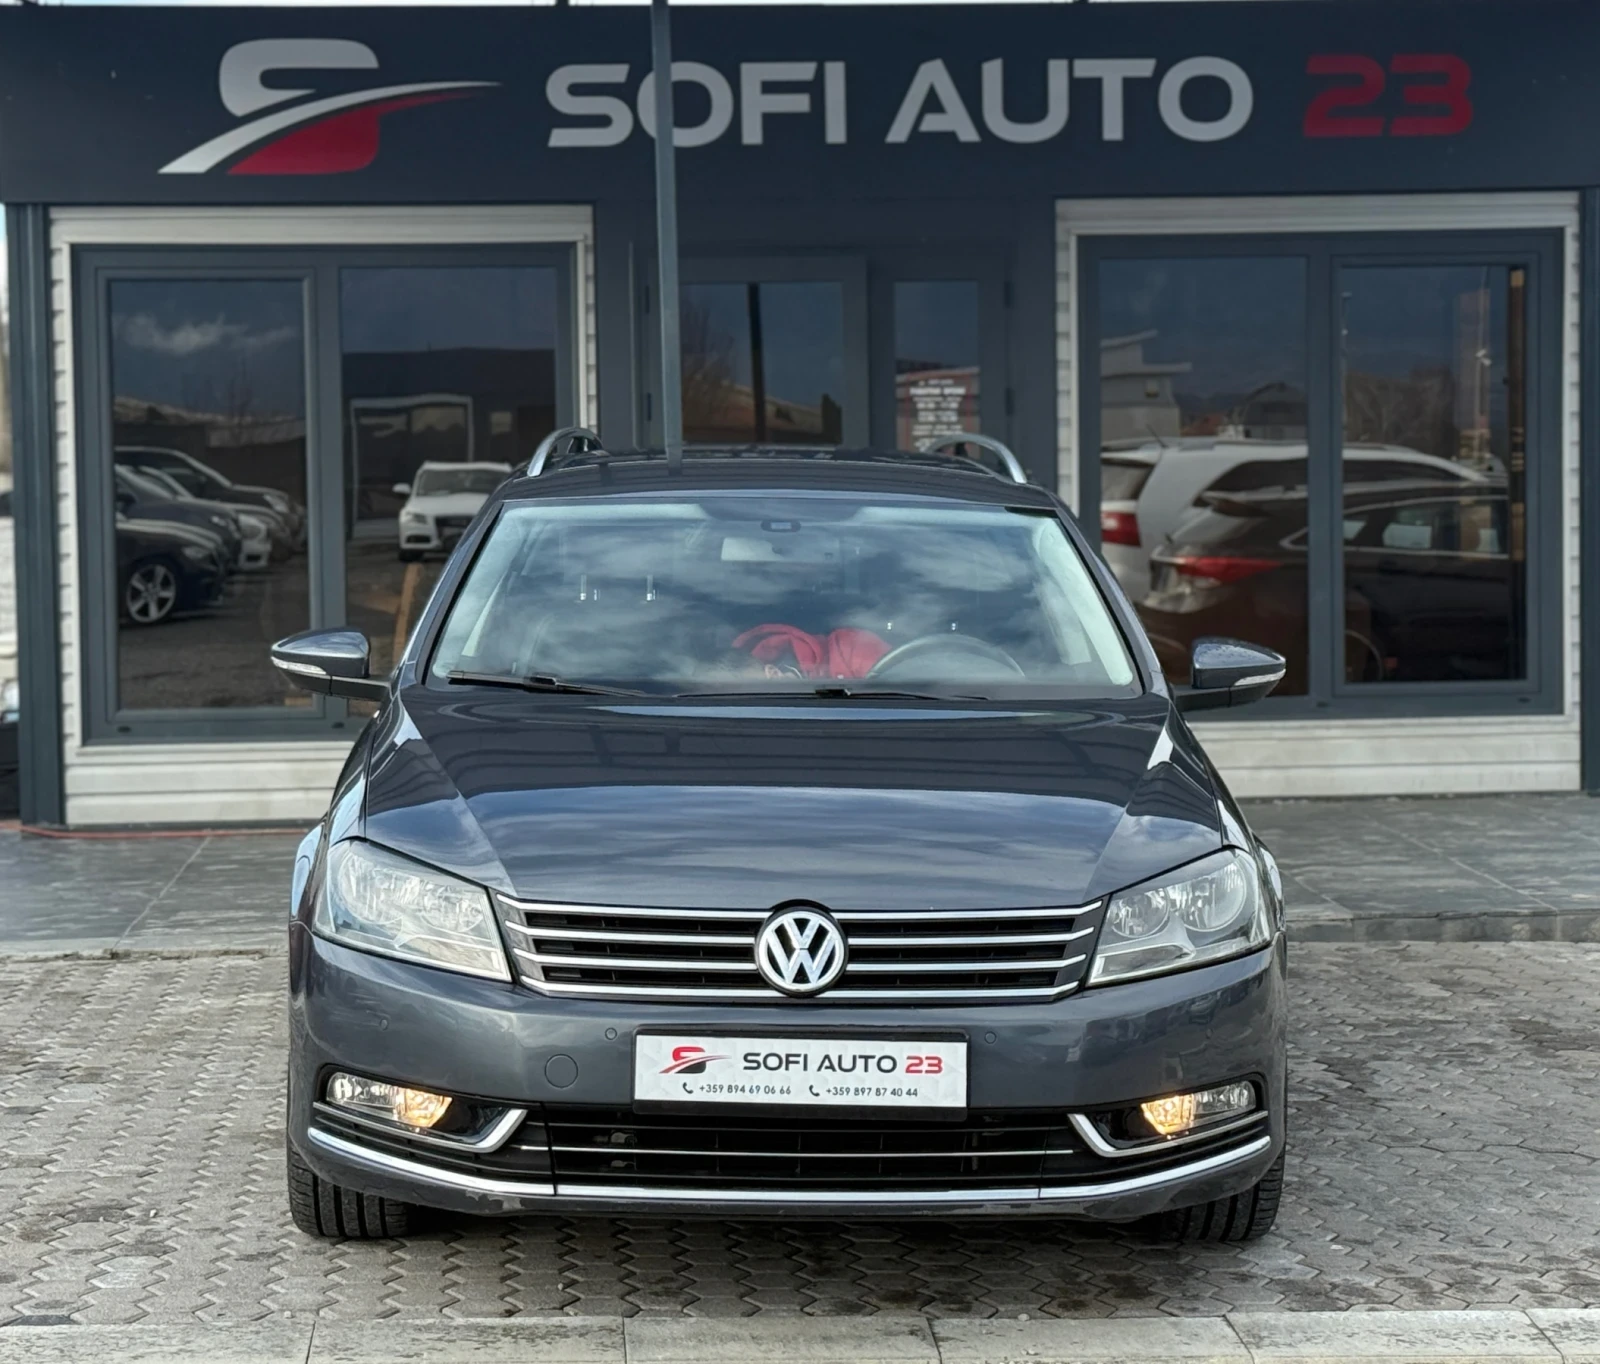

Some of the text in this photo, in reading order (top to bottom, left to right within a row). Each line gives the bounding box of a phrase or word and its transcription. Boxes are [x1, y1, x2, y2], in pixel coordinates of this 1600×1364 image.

[546, 54, 1475, 148] SOFI AUTO 23
[742, 1052, 943, 1075] SOFI AUTO 23
[699, 1084, 792, 1095] +359 894 69 06 66
[826, 1086, 918, 1097] +359 897 87 40 44
